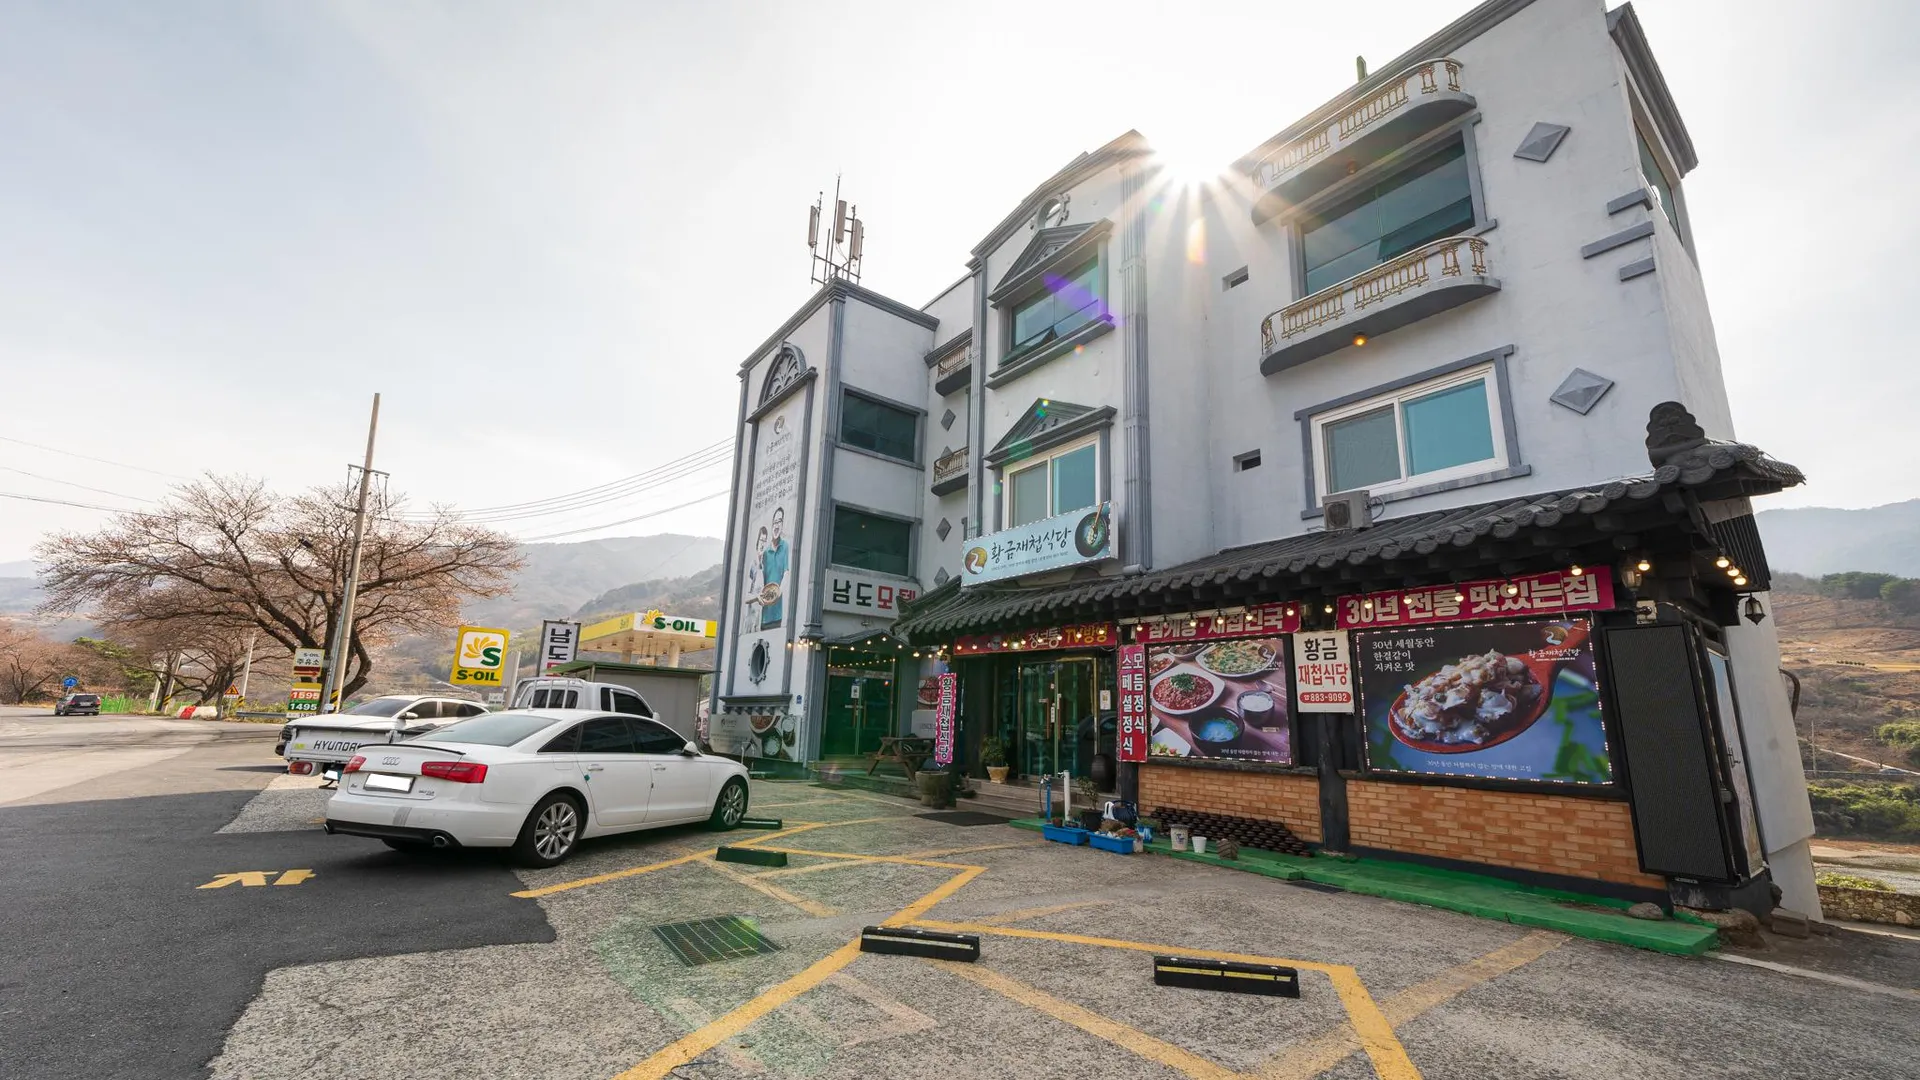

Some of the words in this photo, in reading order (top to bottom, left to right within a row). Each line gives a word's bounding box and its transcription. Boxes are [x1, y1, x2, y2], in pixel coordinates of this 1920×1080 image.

[991, 527, 1072, 564] 황금재첩식당
[1346, 595, 1400, 624] 30년
[1407, 588, 1461, 619] 전통
[1469, 573, 1599, 614] 맛있는집
[654, 616, 700, 633] S-OIL
[1304, 638, 1338, 661] 황금
[1372, 639, 1393, 650] 30년
[1395, 637, 1435, 649] 세월동안
[297, 658, 320, 666] 주유소
[1373, 650, 1411, 662] 한결같이
[1298, 663, 1349, 685] 재첩식당
[1374, 662, 1403, 672] 지켜온
[1405, 661, 1416, 672] 맛
[456, 669, 499, 682] S-OIL
[292, 691, 320, 699] 1595
[1133, 653, 1145, 735] 모듬정식
[1310, 693, 1348, 702] 883-9092
[1122, 654, 1133, 756] 스페셜정식
[939, 677, 953, 760] 황금재첩식당
[313, 740, 361, 752] HYUNDA
